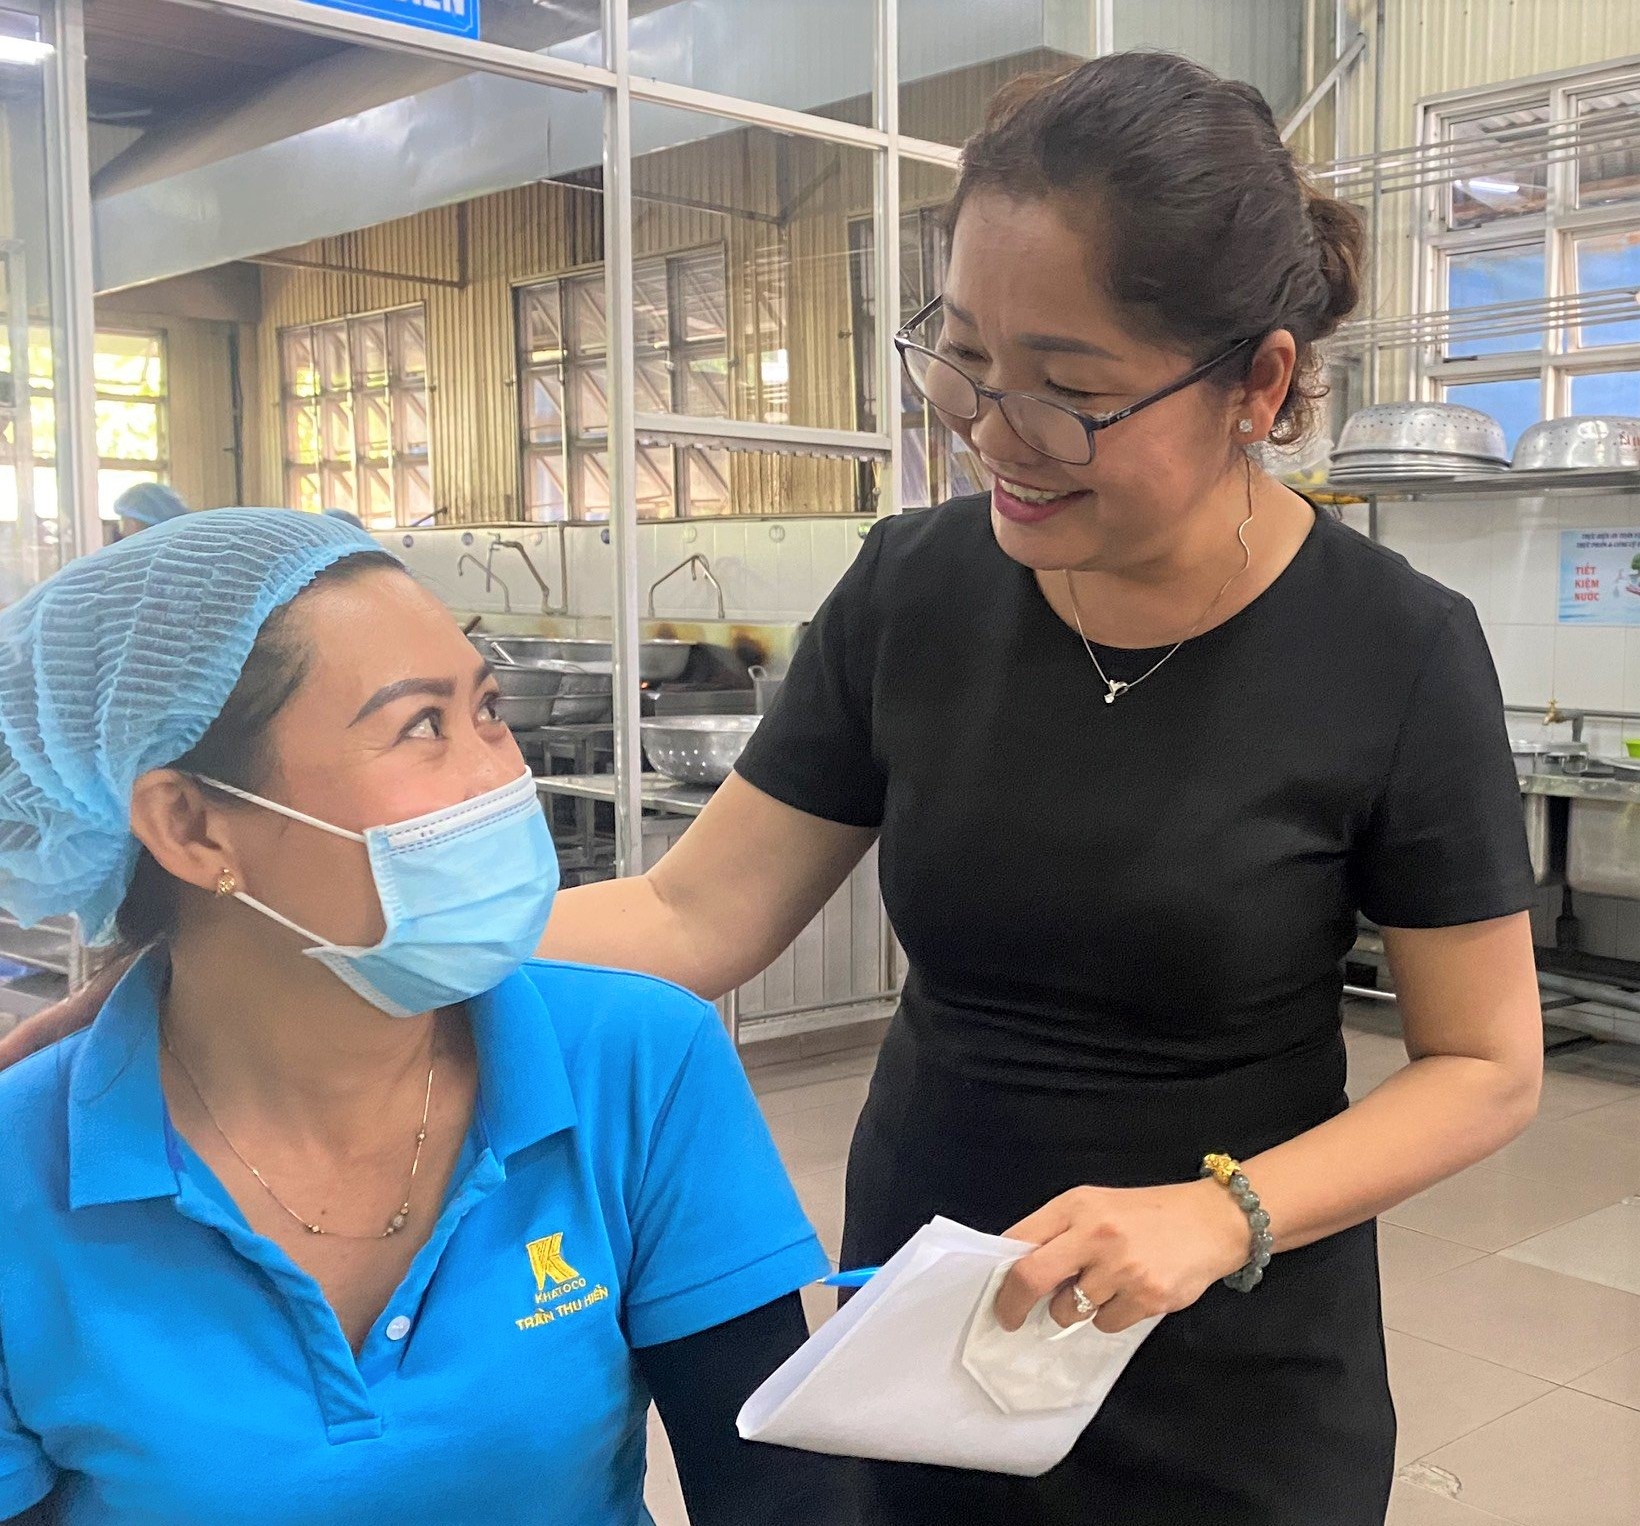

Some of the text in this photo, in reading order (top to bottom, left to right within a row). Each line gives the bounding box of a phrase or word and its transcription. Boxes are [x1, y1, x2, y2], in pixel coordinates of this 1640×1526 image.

[1575, 562, 1596, 575] TIẾT
[1575, 578, 1599, 590] KIỆM
[534, 1278, 586, 1304] KHATOCO
[515, 1307, 555, 1330] TRẦN
[555, 1299, 582, 1317] THU
